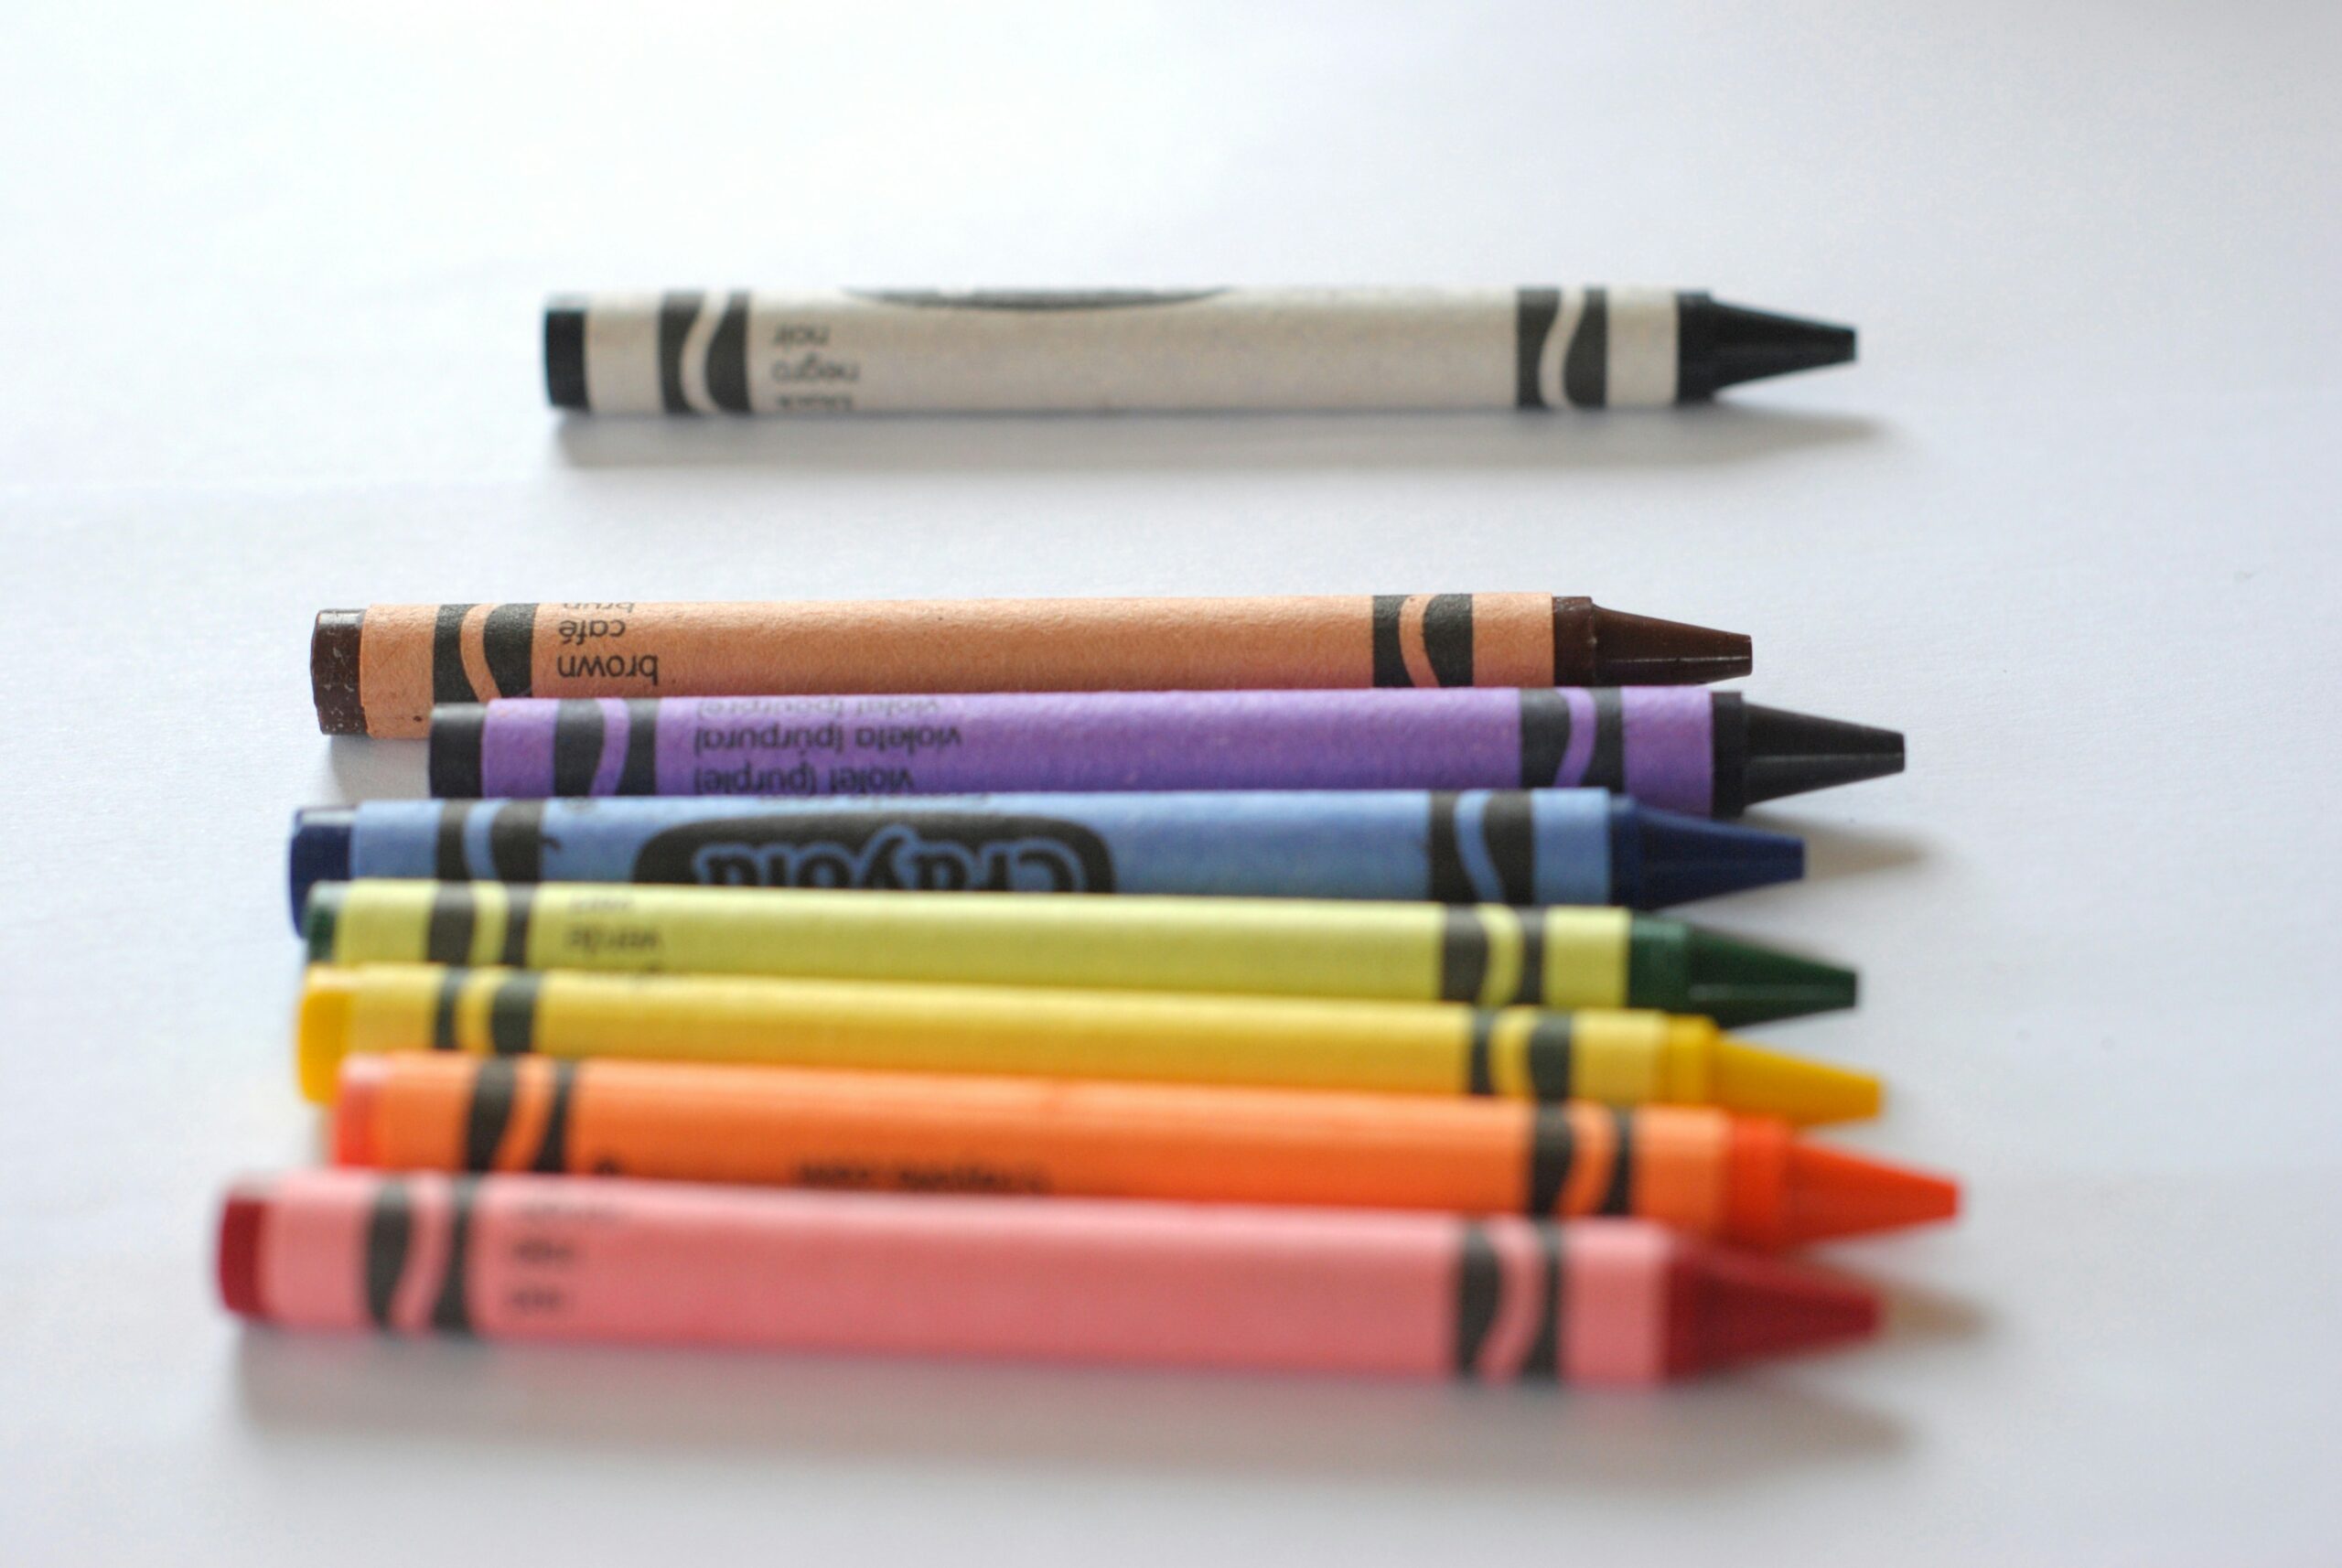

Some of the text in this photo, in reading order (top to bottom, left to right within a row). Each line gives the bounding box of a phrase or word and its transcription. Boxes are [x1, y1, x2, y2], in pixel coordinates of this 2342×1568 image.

[772, 324, 831, 349] noir
[770, 352, 861, 383] negro
[557, 619, 626, 645] café
[556, 655, 658, 686] brown
[854, 724, 962, 754] violeta
